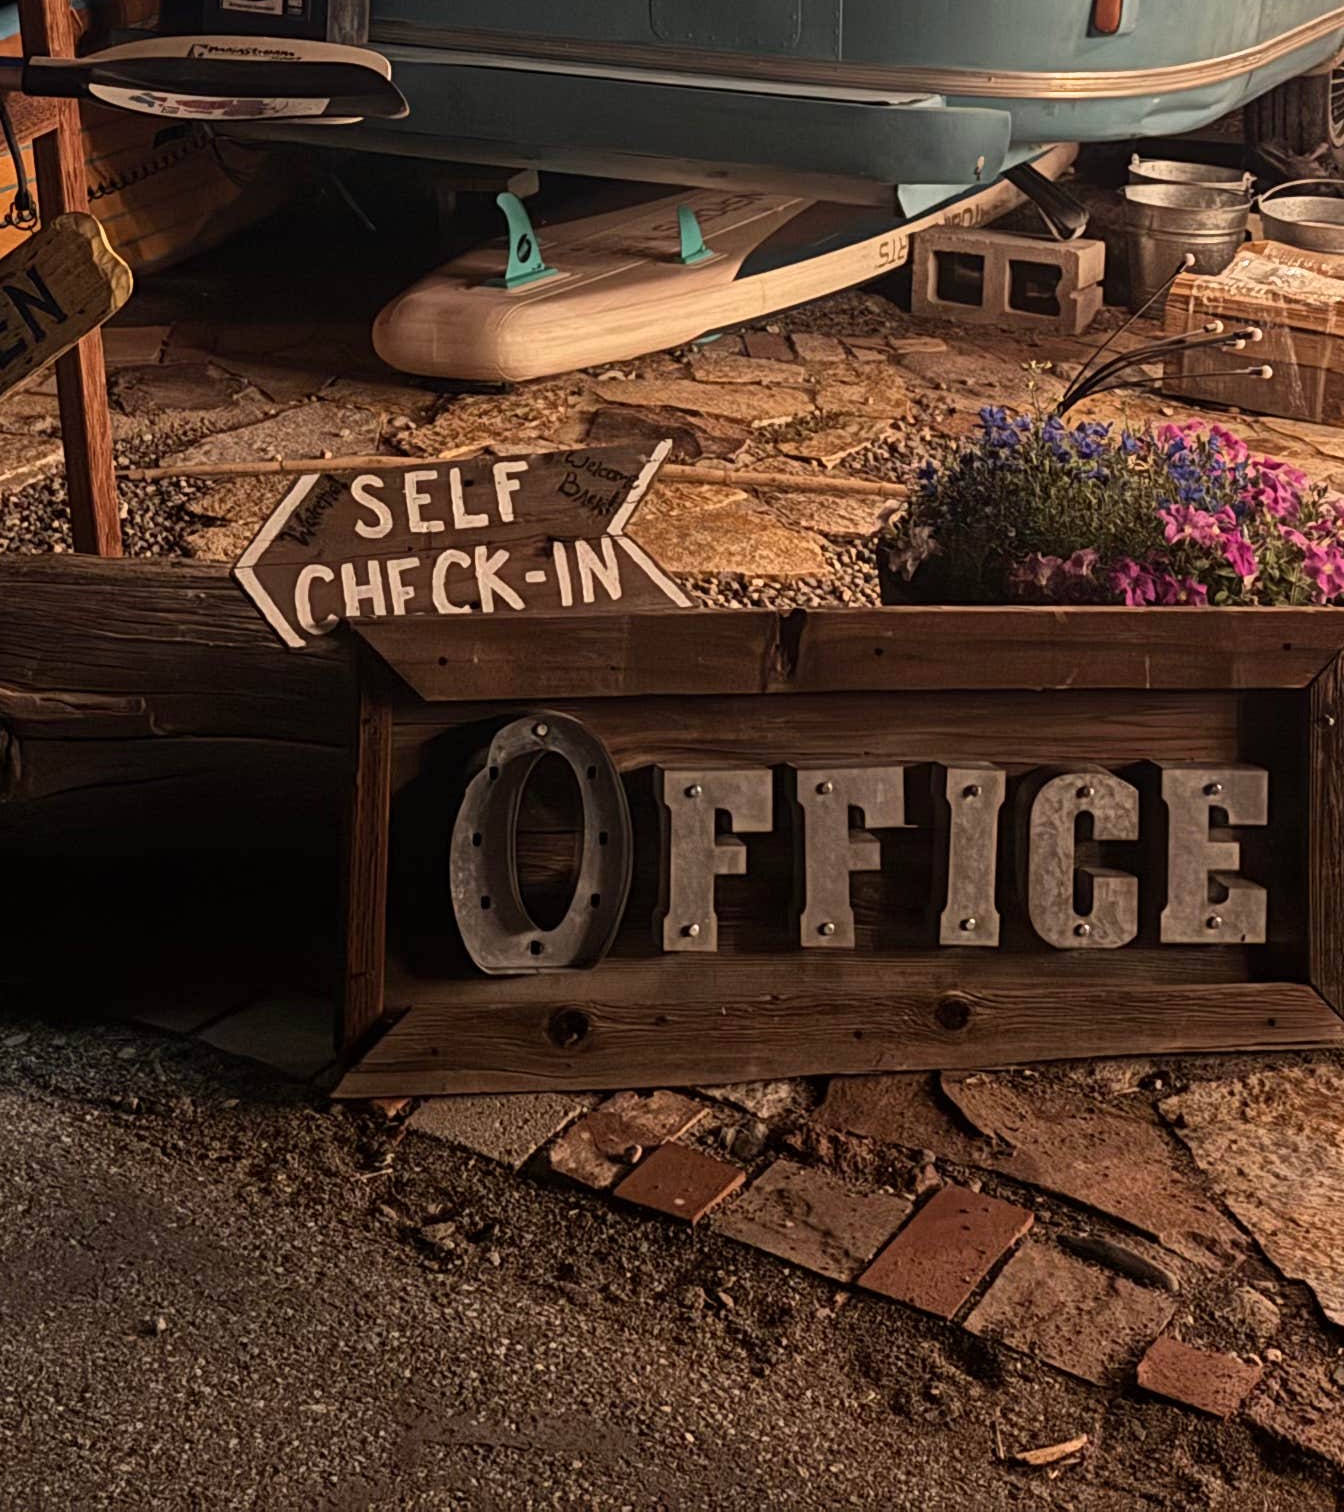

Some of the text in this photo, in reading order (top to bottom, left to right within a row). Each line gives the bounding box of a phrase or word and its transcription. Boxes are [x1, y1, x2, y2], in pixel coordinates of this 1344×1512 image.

[350, 460, 529, 540] SELF
[293, 535, 623, 636] CHECK-IN
[450, 709, 1270, 975] OFFICE
